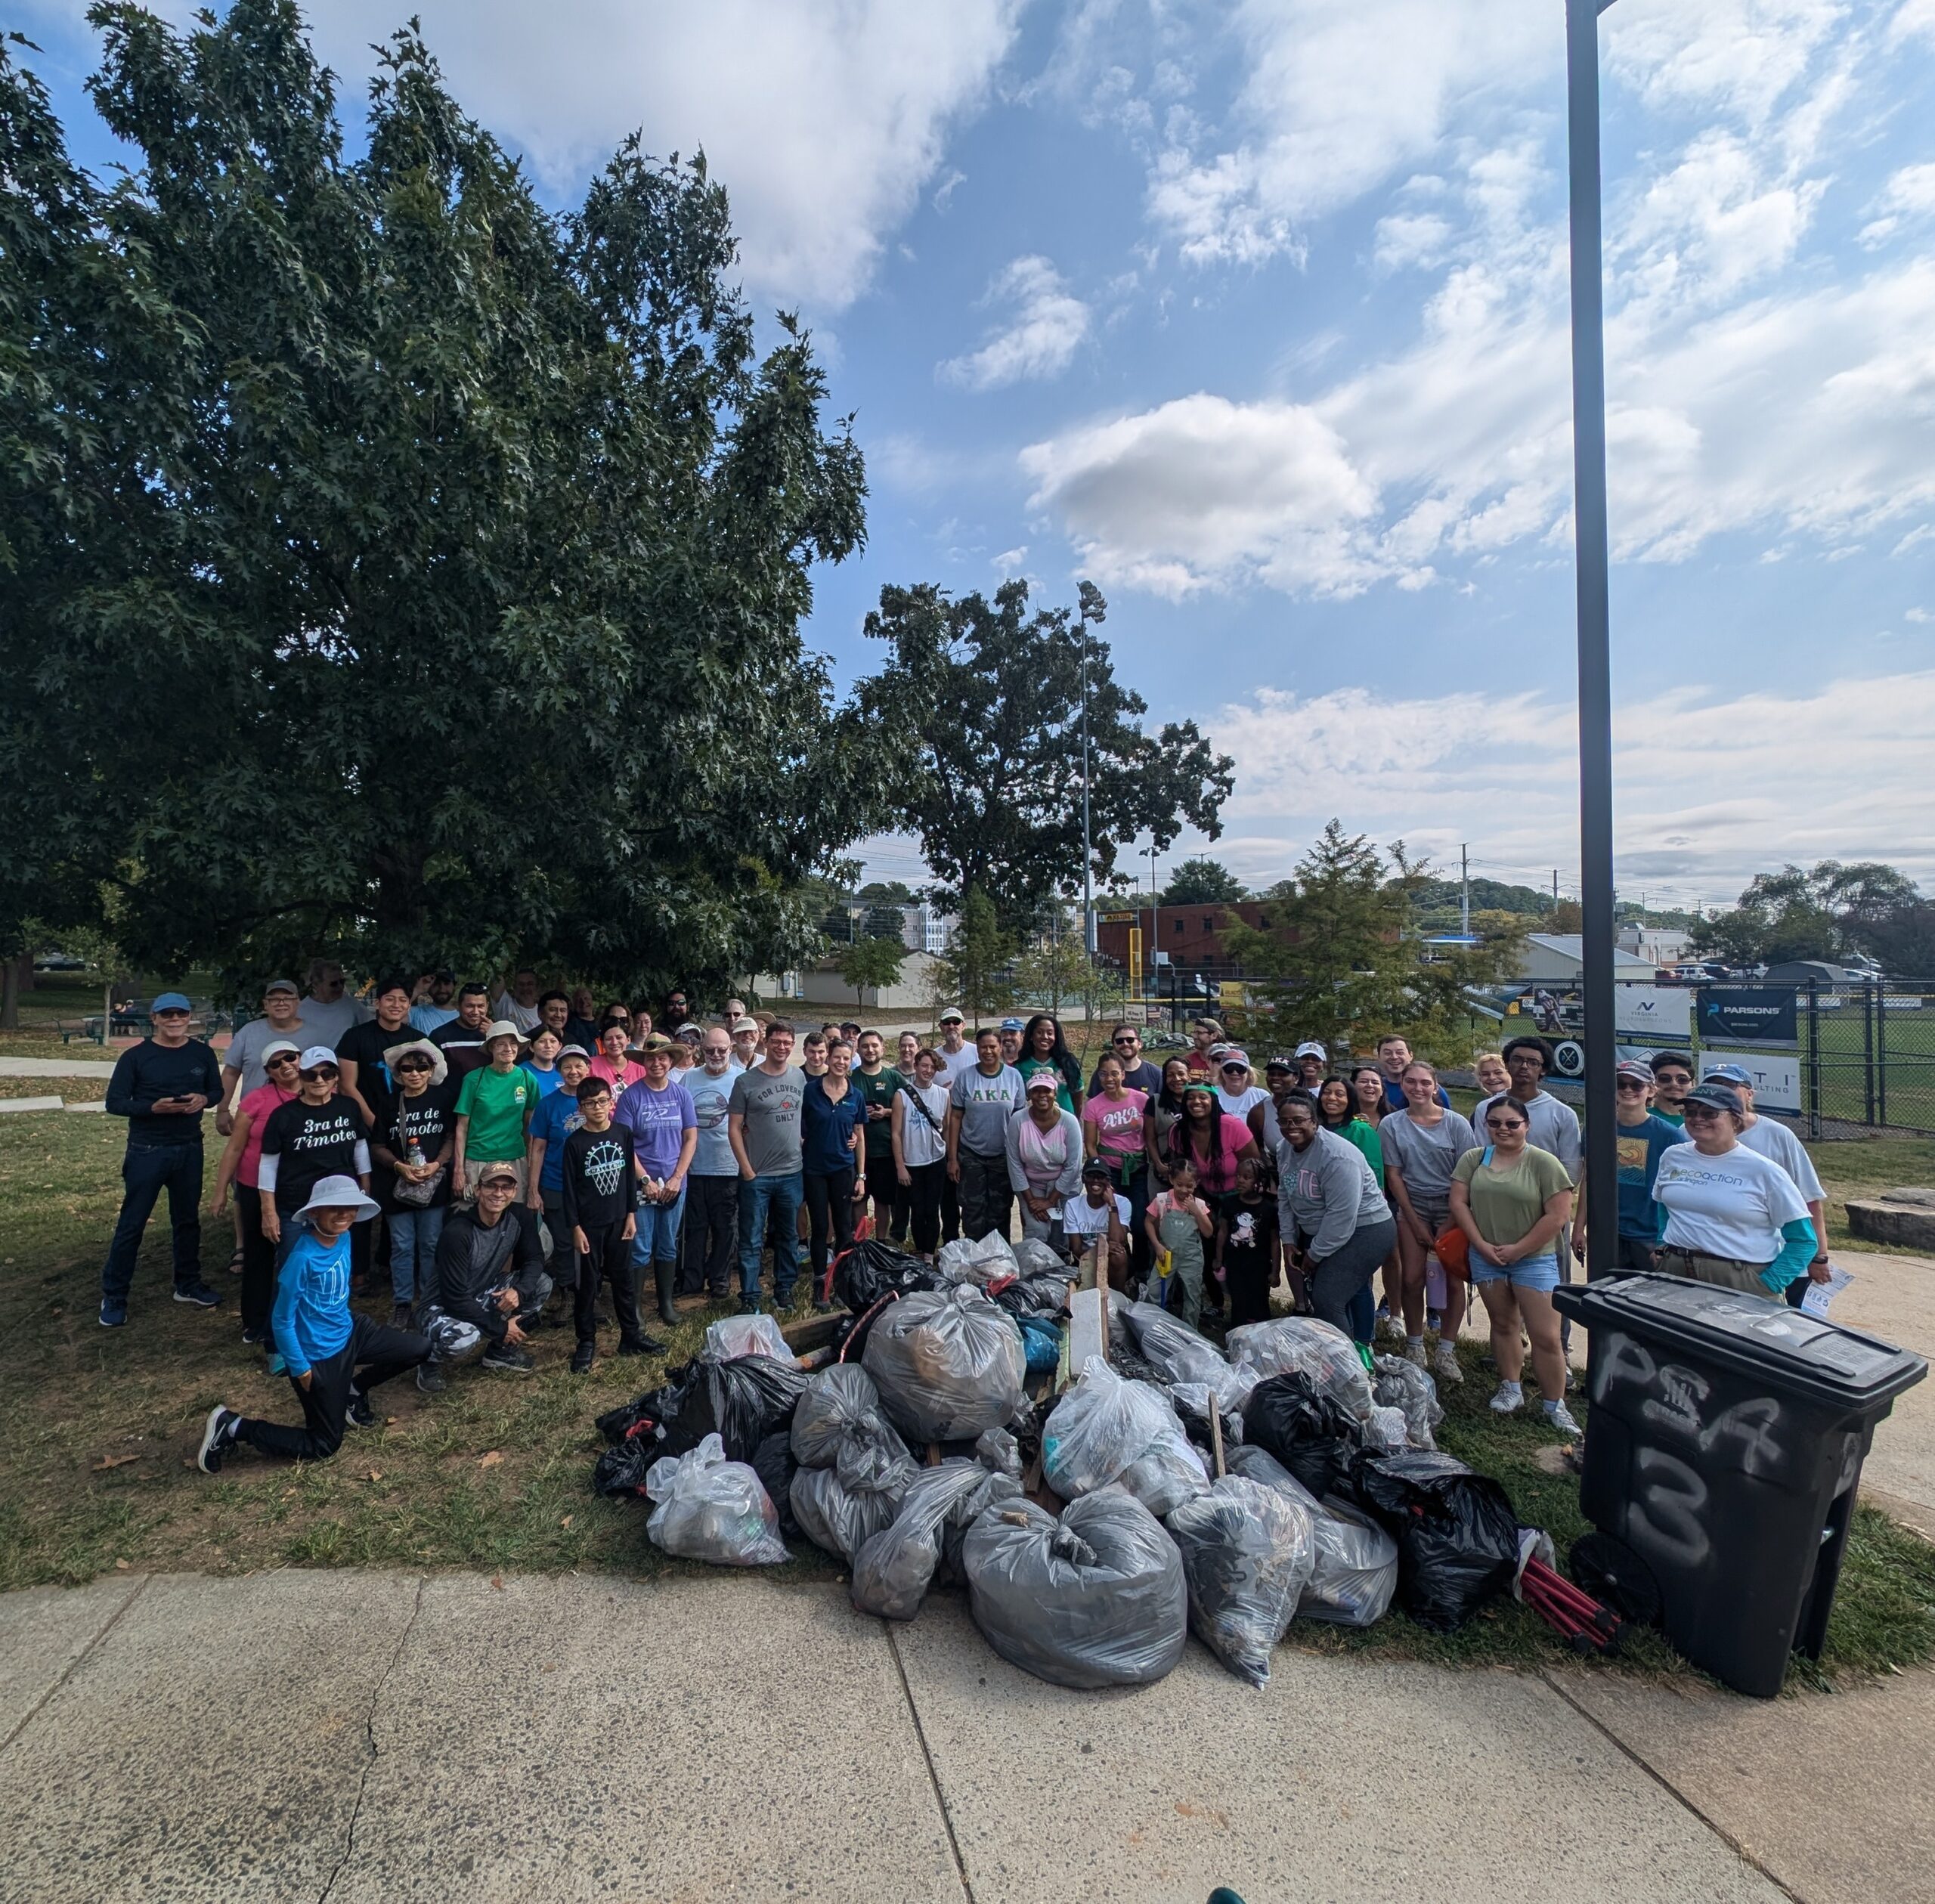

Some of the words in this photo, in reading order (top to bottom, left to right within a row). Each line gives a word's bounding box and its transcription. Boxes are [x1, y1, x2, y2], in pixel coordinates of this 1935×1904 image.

[1271, 1057, 1289, 1066] AKA
[757, 1088, 774, 1101] FOR
[775, 1085, 802, 1097] LOVERS
[973, 1089, 1011, 1101] AKA
[1754, 1085, 1790, 1094] ULTING
[424, 1108, 440, 1119] de
[776, 1113, 794, 1122] ONLY
[1103, 1107, 1139, 1130] AKA
[304, 1119, 331, 1134] 3ra
[335, 1116, 350, 1128] de
[389, 1122, 444, 1140] Tmoteo
[293, 1130, 357, 1150] Timoteo
[1680, 1169, 1743, 1186] ecoaction
[1628, 1446, 1710, 1566] 3
